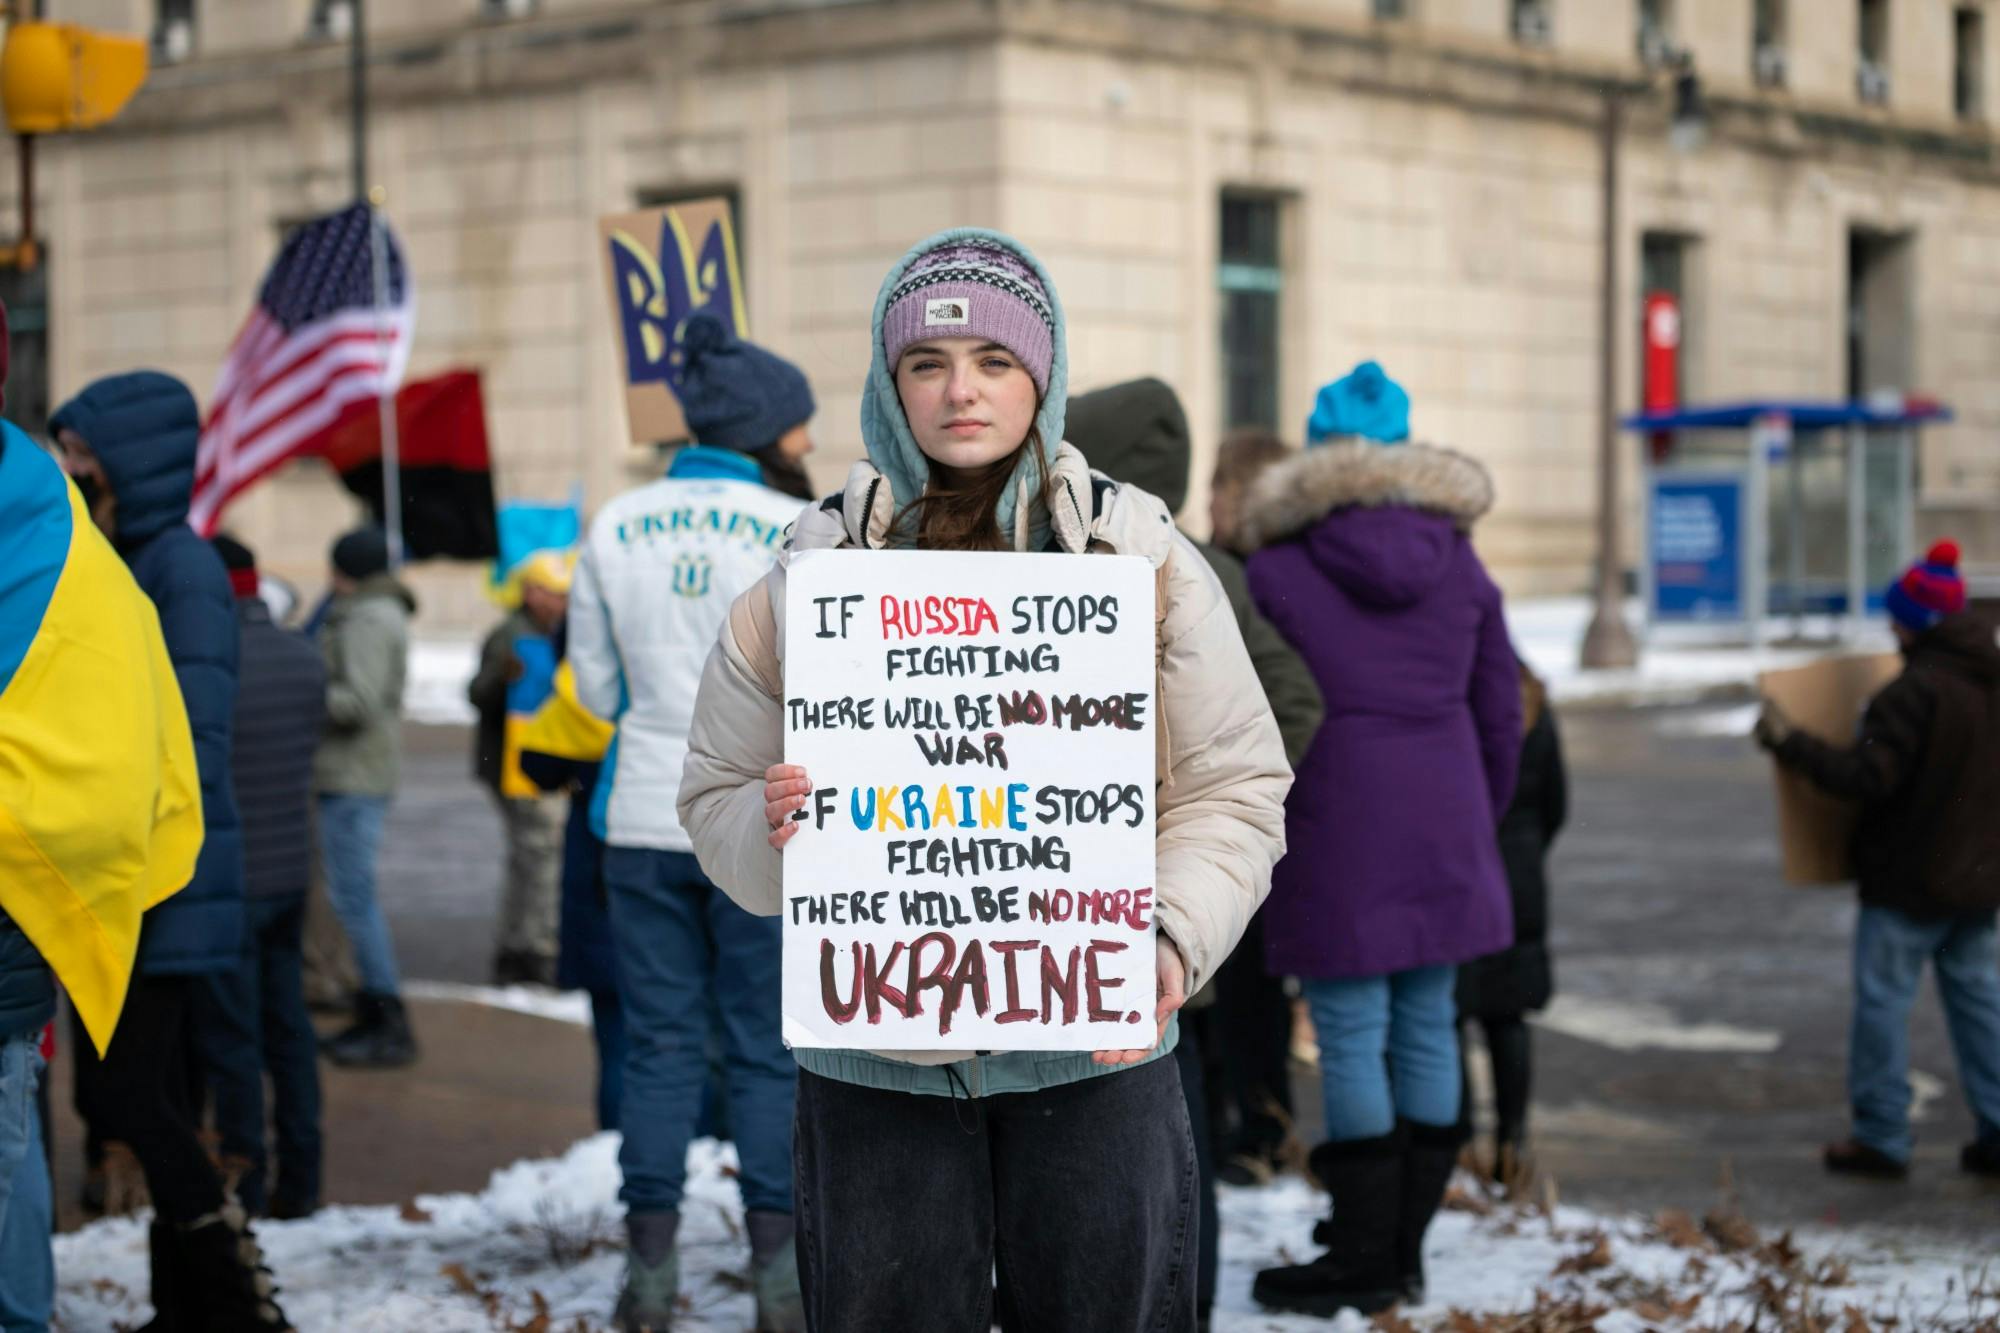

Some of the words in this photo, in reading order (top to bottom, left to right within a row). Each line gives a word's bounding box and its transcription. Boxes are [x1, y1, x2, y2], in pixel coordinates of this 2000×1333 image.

[813, 595, 864, 639] IF
[881, 595, 999, 640] RUSSIA
[1012, 595, 1118, 635] STOPS
[887, 643, 1059, 681] FIGHTING
[787, 696, 874, 731] THERE
[885, 697, 950, 730] WILL
[955, 694, 993, 731] BE
[997, 690, 1047, 725] NO
[1052, 693, 1148, 731] MORE
[914, 732, 1008, 770] WAR
[851, 783, 1029, 832] UKRAINE
[1036, 784, 1144, 828] STOPS
[887, 836, 1070, 877] FIGHTING
[790, 891, 889, 925] THERE
[899, 890, 971, 928] WILL
[971, 886, 1019, 923] BE
[1029, 889, 1072, 925] NO
[1078, 887, 1153, 930] MORE
[820, 931, 1141, 1036] UKRAINE.
